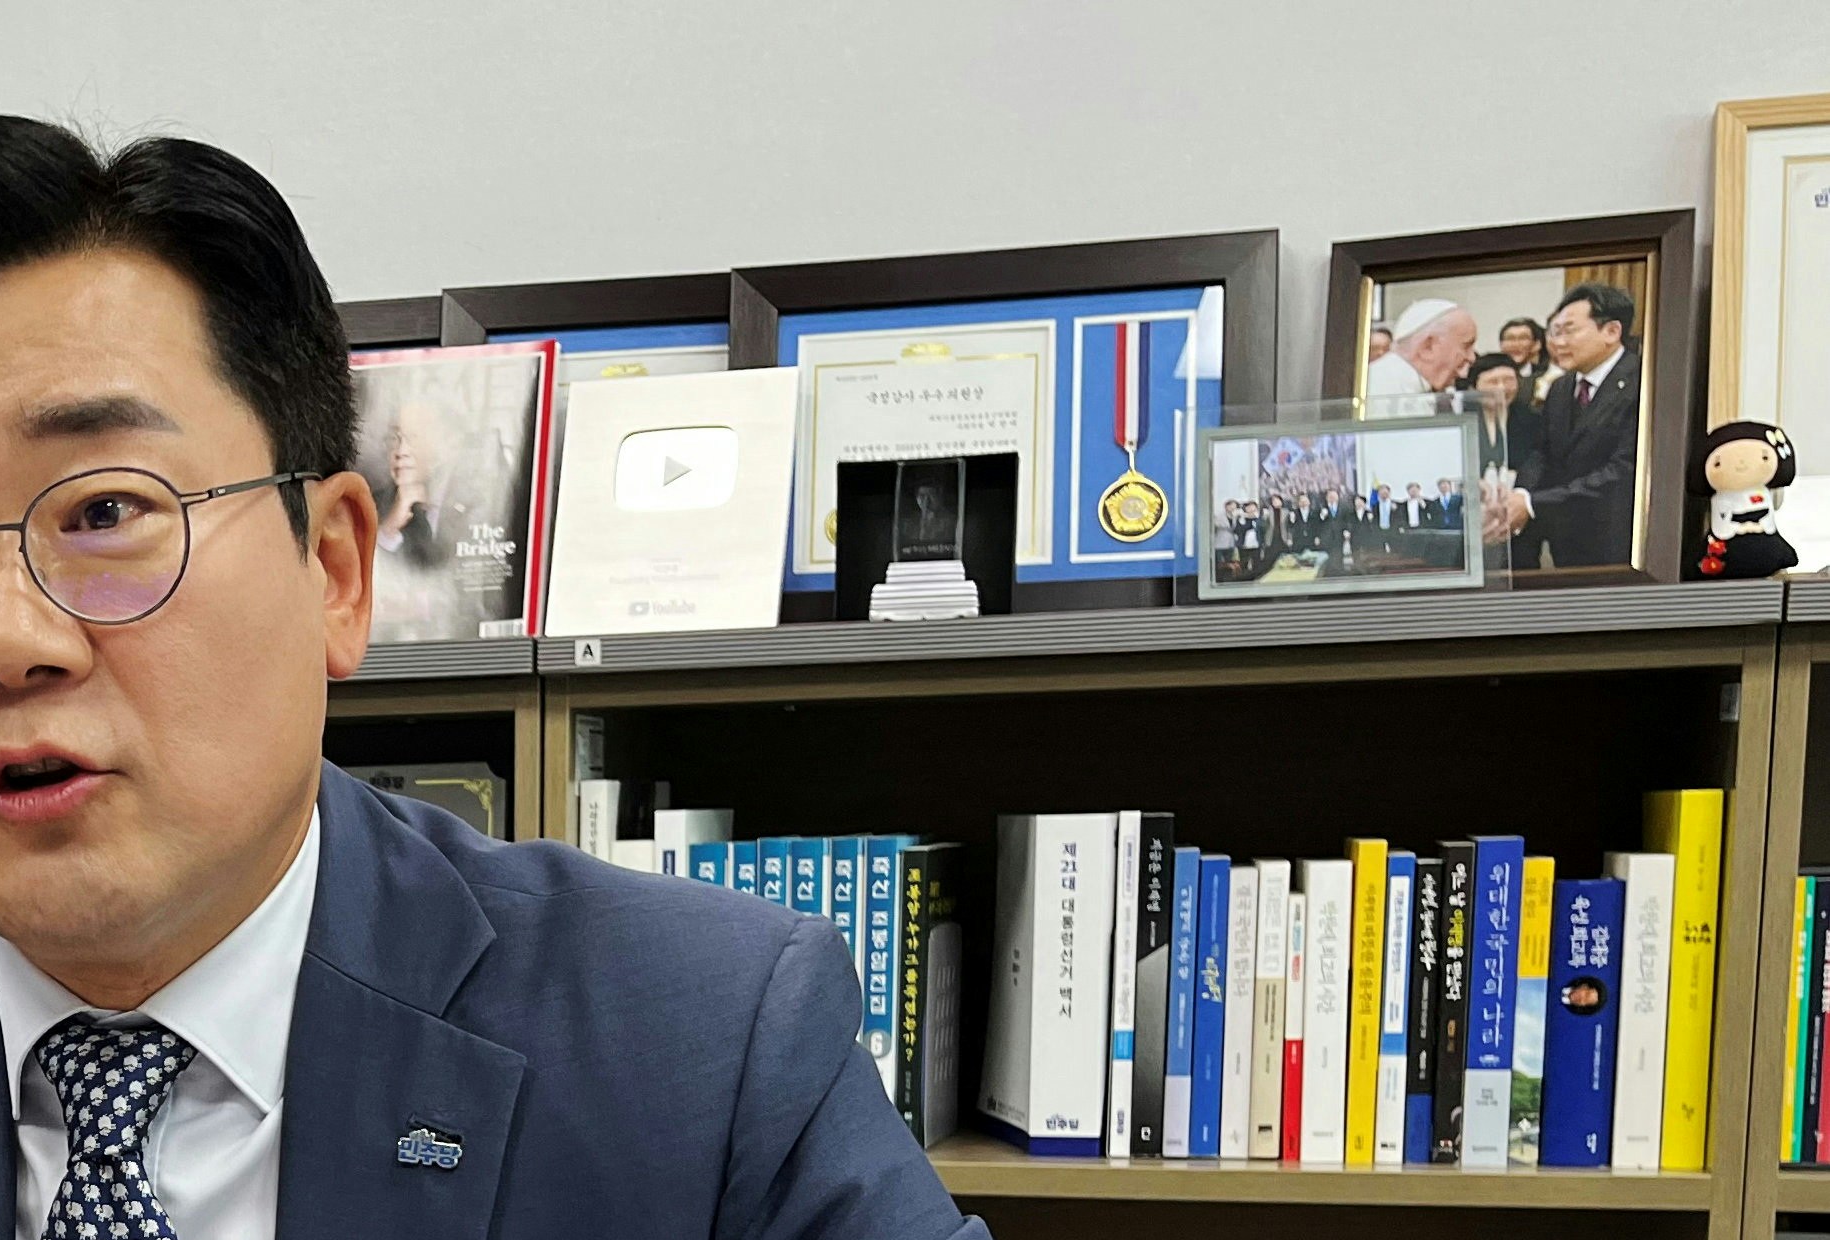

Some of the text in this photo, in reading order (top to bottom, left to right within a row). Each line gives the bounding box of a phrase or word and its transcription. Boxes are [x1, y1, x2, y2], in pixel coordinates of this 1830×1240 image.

[468, 523, 505, 540] The
[456, 539, 517, 561] Bridge
[582, 642, 594, 657] A
[1567, 894, 1591, 969] 육성 회고록
[1590, 924, 1611, 969] 김대중
[398, 1137, 462, 1169] 민주당
